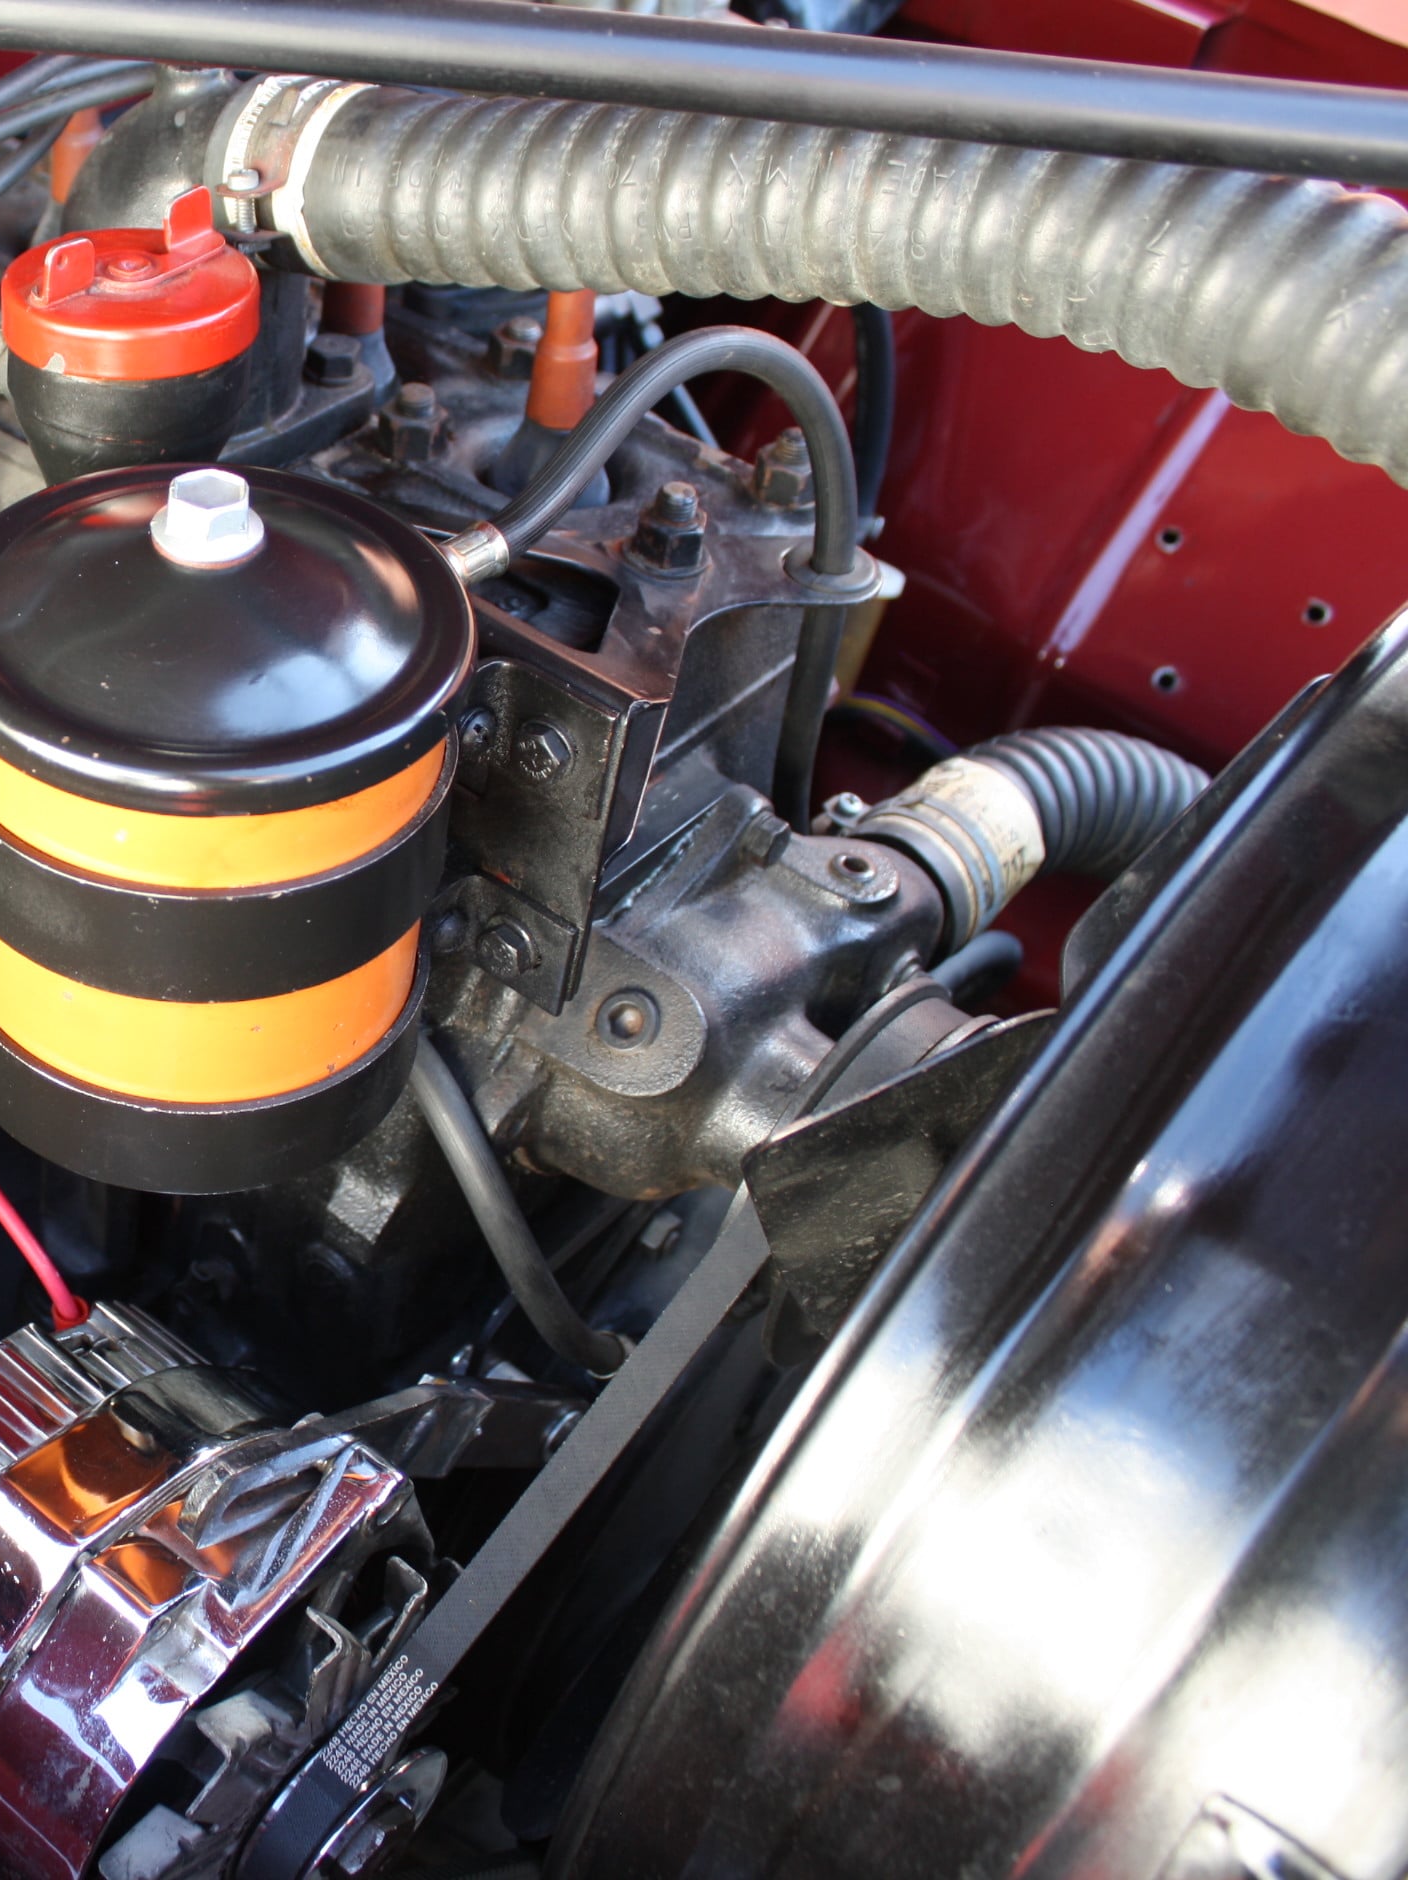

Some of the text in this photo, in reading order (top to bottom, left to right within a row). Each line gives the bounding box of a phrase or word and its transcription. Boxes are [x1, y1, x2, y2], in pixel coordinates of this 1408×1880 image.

[318, 1655, 408, 1761] 2248 HECHO EN MEXICO
[325, 1672, 408, 1769] 2248 MADE IN MEXICO
[335, 1669, 423, 1775] 2248 HECHO EN MEXICO
[341, 1686, 422, 1783] 2248 MADE IN MEXICO
[350, 1682, 438, 1788] 2248 HECHO EN MEXICO
